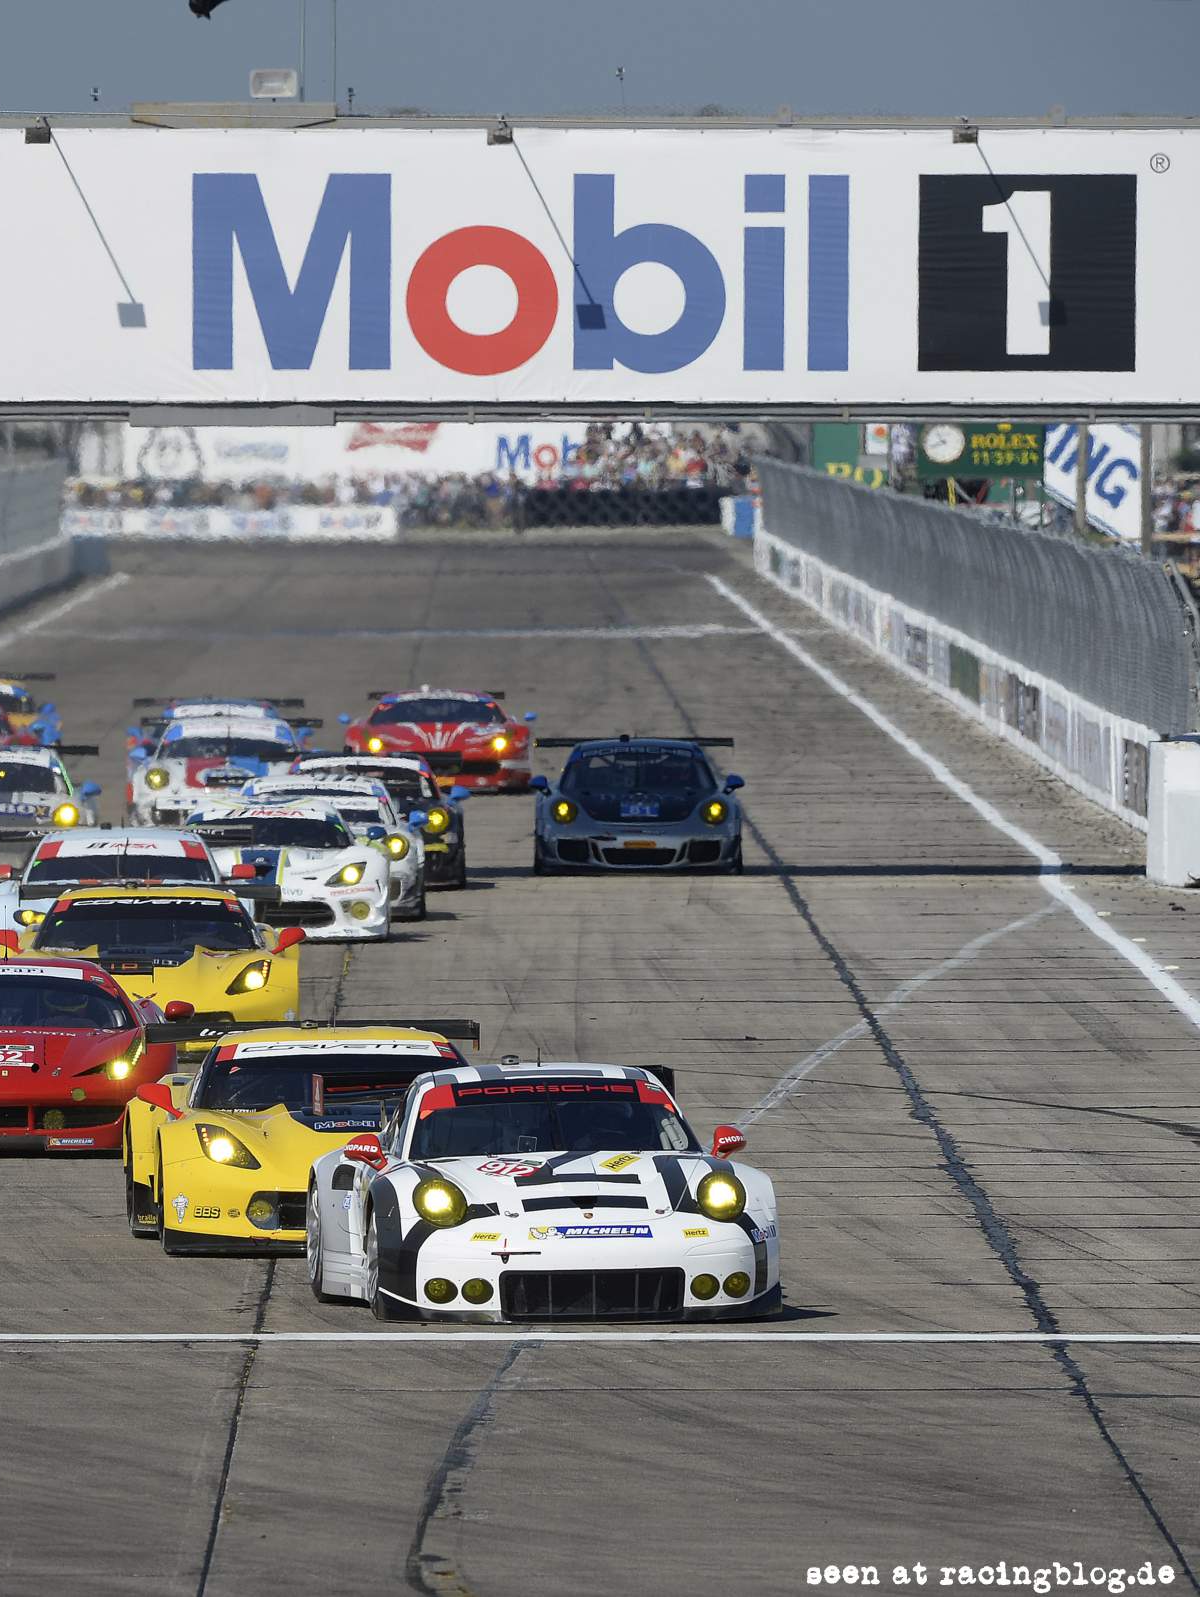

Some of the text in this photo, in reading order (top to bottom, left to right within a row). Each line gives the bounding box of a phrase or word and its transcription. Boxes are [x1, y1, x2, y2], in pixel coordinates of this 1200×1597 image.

[192, 172, 850, 376] Mobil
[981, 189, 1052, 356] 1
[971, 433, 1040, 449] ROLEX
[1044, 424, 1138, 509] ING
[250, 809, 305, 817] IMSA
[110, 842, 158, 850] IMSA
[72, 898, 222, 907] CORVETTE
[241, 1043, 431, 1053] CORVETTE
[457, 1084, 635, 1098] PORSCHE
[313, 1119, 376, 1131] Mobil
[60, 1137, 94, 1146] MICHELIN
[718, 1135, 746, 1144] CHOPA
[345, 1144, 379, 1153] HOPARD
[607, 1154, 635, 1171] Hertz
[481, 1161, 537, 1176] 912
[194, 1206, 221, 1218] BBS
[566, 1225, 650, 1236] MICHELIN
[685, 1228, 707, 1237] Hertz
[473, 1233, 498, 1241] Hertz
